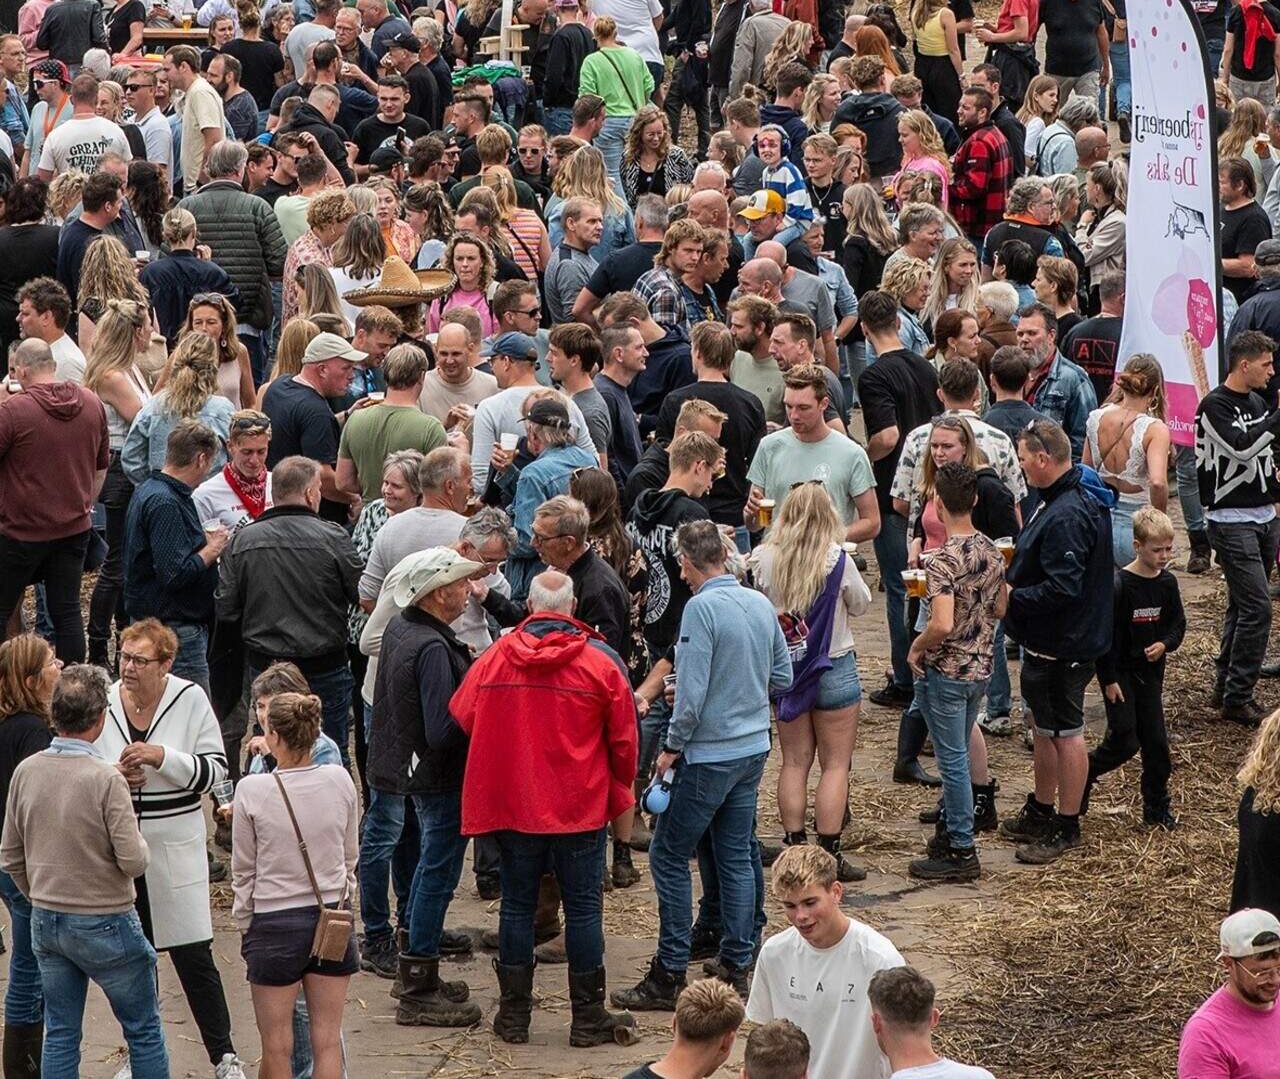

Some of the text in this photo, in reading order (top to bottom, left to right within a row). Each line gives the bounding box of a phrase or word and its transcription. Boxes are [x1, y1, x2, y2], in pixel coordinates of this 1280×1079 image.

[69, 140, 108, 156] GREAT
[65, 155, 98, 167] THIN
[815, 981, 824, 993] A
[847, 983, 855, 995] 7
